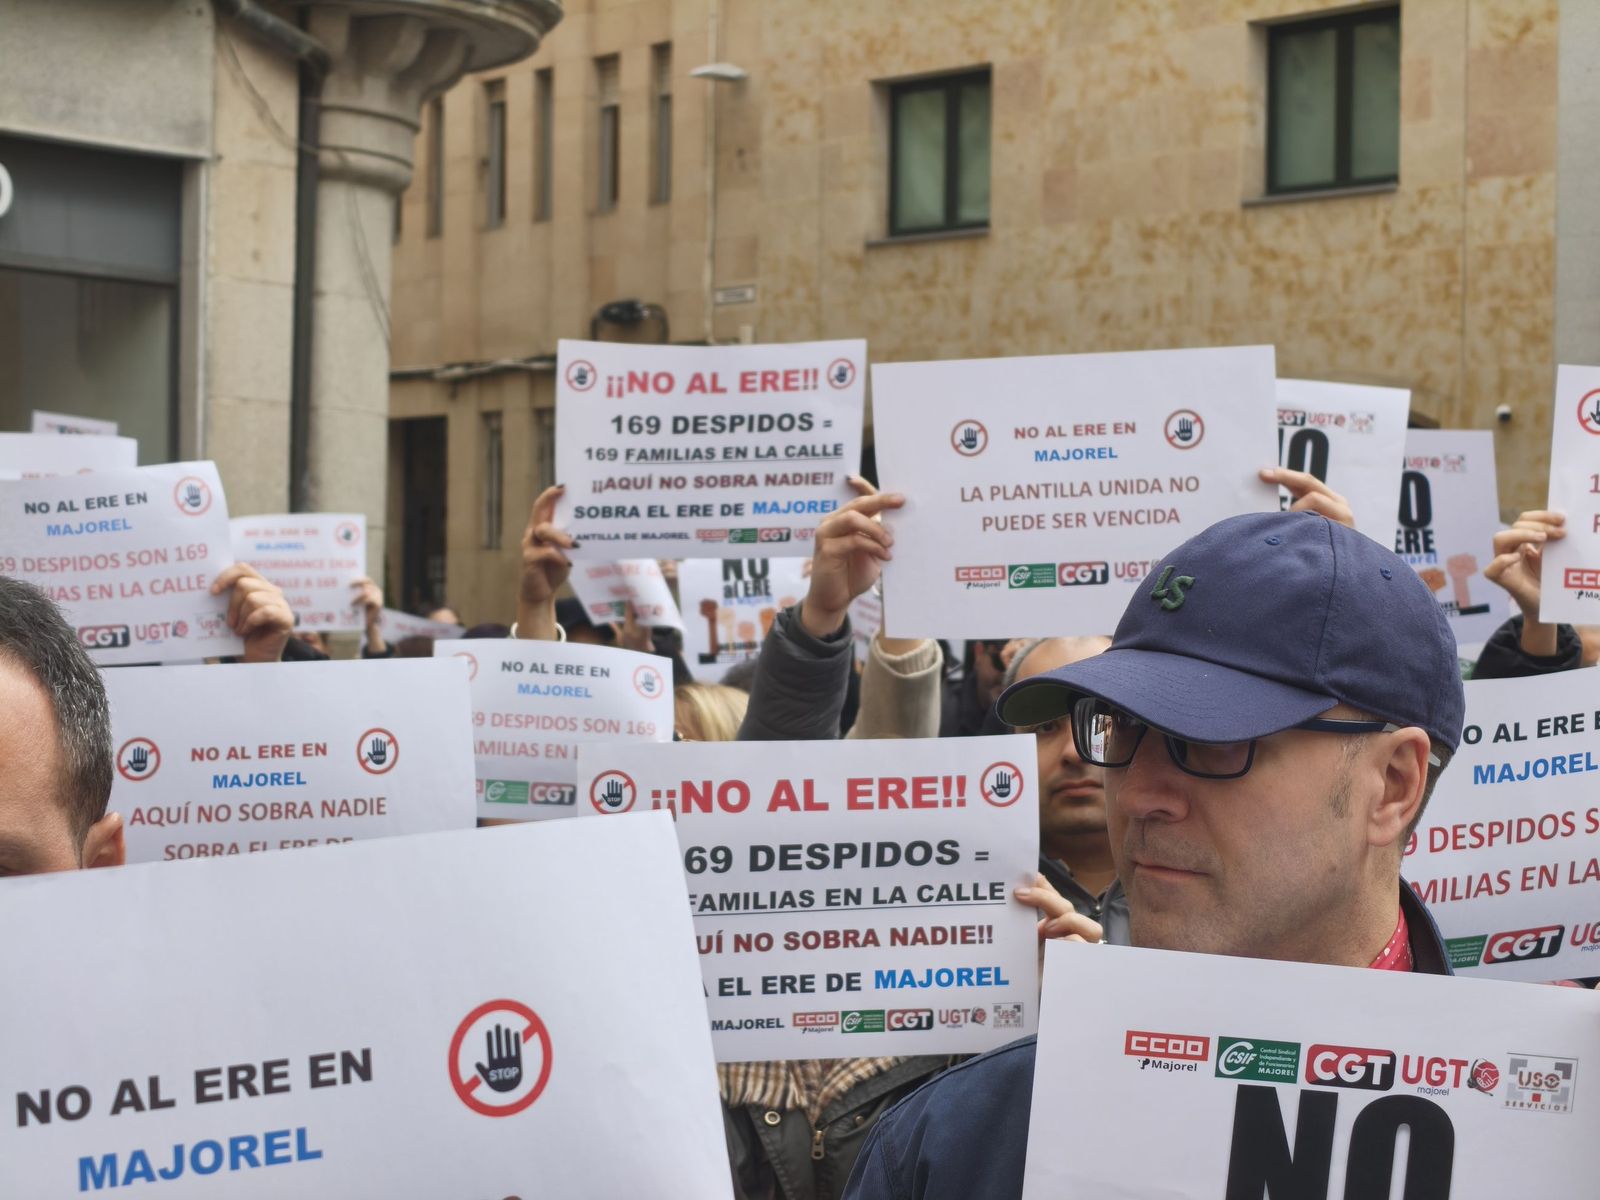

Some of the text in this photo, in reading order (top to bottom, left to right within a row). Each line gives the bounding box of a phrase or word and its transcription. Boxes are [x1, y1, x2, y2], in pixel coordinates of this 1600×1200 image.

[685, 372, 728, 394] AL
[739, 368, 819, 393] ERE!!
[610, 415, 661, 435] 169
[672, 412, 814, 434] DESPIDOS
[1308, 413, 1333, 425] UGT
[1014, 422, 1136, 440] NO AL ERE EN
[585, 443, 844, 463] 169 FAMILIAS EN LA CALLE
[1034, 447, 1118, 462] MAJOREL
[1407, 456, 1430, 468] UGT
[659, 475, 687, 490] NO
[693, 474, 758, 489] SOBRA
[764, 472, 834, 487] NADIE!!
[961, 475, 1200, 502] LA PLANTILLA UNIDA NO
[24, 492, 148, 514] NO AL ERE EN
[574, 504, 640, 520] SOBRA
[647, 504, 670, 519] EL
[676, 503, 713, 518] ERE
[720, 503, 745, 517] DE
[46, 519, 132, 536] MAJOREL
[981, 508, 1179, 532] PUEDE SER VENCIDA
[573, 533, 621, 541] ANTILLA
[624, 532, 637, 541] DE
[641, 531, 690, 541] MAJOREL
[761, 530, 788, 542] CGT
[23, 544, 208, 573] DESPIDOS SON 169
[957, 568, 1004, 579] CCOO
[1061, 564, 1106, 583] CGT
[1114, 561, 1149, 578] UGT
[87, 574, 206, 600] EN LA CALLE
[82, 628, 126, 646] CGT
[135, 623, 170, 641] UGT
[501, 661, 610, 678] NO AL ERE EN
[517, 683, 592, 699] MAJOREL
[491, 713, 656, 736] DESPIDOS SON 169
[1492, 722, 1527, 743] AL
[1536, 713, 1585, 738] ERE
[191, 743, 328, 762] NO AL ERE EN
[545, 744, 568, 760] EN
[1474, 752, 1598, 785] MAJOREL
[212, 772, 307, 789] MAJOREL
[533, 786, 575, 803] CGT
[767, 778, 830, 812] AL
[846, 775, 967, 812] ERE!!
[130, 797, 387, 827] AQUÍ NO SOBRA NADIE
[1429, 811, 1576, 853] DESPIDOS
[164, 842, 240, 861] SOBRA
[749, 839, 961, 873] DESPIDOS
[1520, 863, 1559, 892] EN
[1568, 858, 1600, 884] LA
[825, 886, 863, 907] EN
[872, 884, 907, 904] LA
[916, 881, 1006, 902] CALLE
[733, 931, 774, 952] NO
[783, 927, 880, 950] SOBRA
[889, 925, 994, 946] NADIE!!
[1491, 929, 1560, 960] CGT
[718, 977, 751, 997] EL
[761, 975, 815, 995] ERE
[826, 972, 861, 992] DE
[874, 966, 1009, 989] MAJOREL
[711, 1018, 785, 1031] MAJOREL
[795, 1014, 837, 1024] CCOO
[890, 1011, 931, 1028] CGT
[939, 1009, 971, 1024] UGT
[1131, 1035, 1204, 1056] CCOO
[489, 1066, 519, 1082] STOP
[1151, 1059, 1198, 1072] Majorel
[1257, 1067, 1295, 1077] MAJOREL
[1313, 1051, 1391, 1084] CGT
[1402, 1055, 1469, 1088] UGT
[15, 1047, 374, 1127] NO AL ERE EN
[1518, 1070, 1560, 1089] USO
[1416, 1086, 1450, 1096] majorel
[1505, 1100, 1568, 1111] SERVICIOS
[1226, 1084, 1455, 1200] NO
[77, 1126, 324, 1192] MAJOREL
